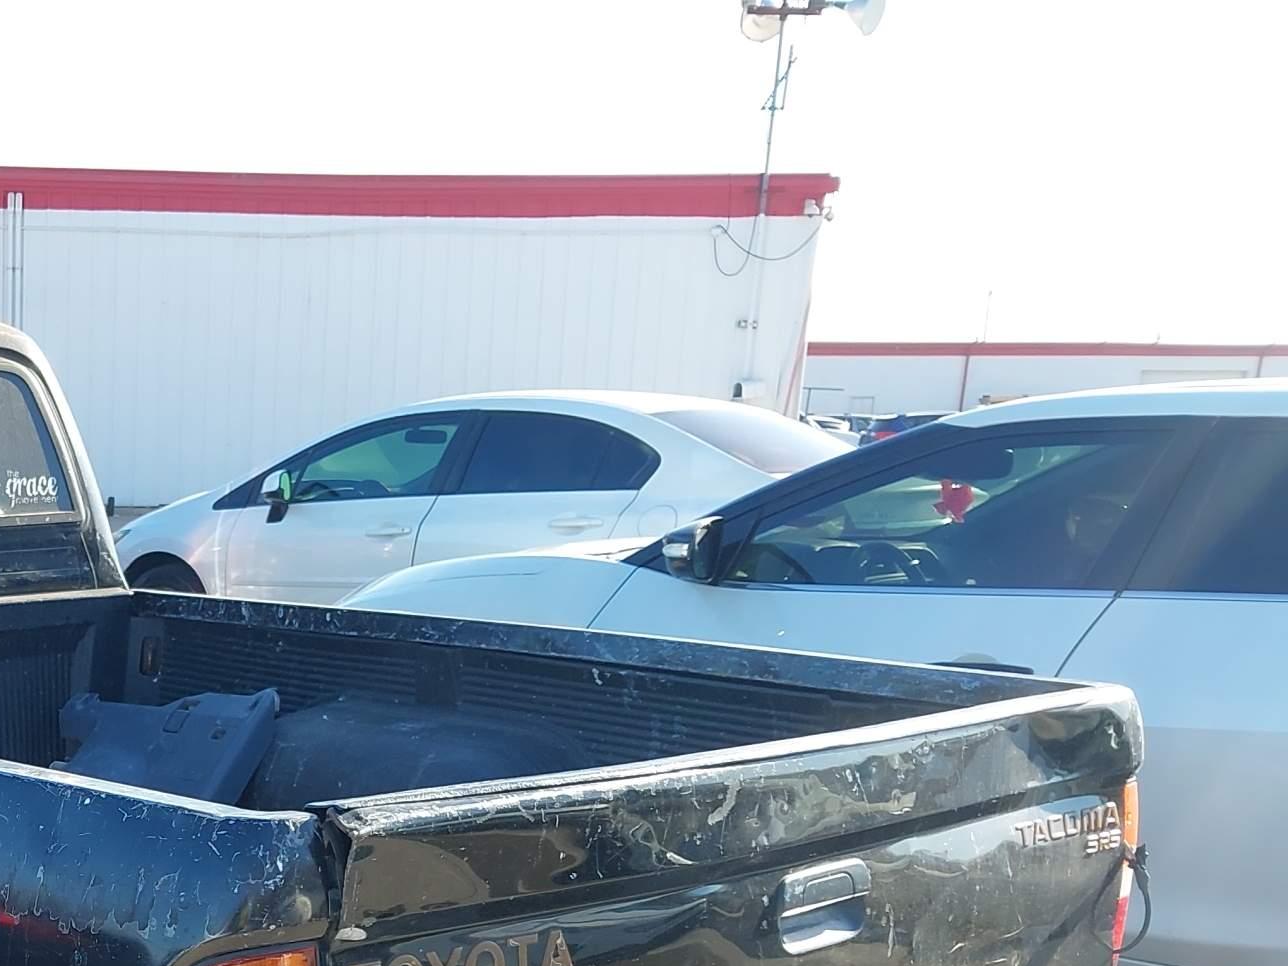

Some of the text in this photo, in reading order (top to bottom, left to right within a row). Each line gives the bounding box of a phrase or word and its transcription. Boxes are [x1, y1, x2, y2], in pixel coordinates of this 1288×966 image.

[5, 475, 59, 509] grace
[1015, 801, 1120, 849] TACOMA
[1085, 829, 1121, 854] SR5
